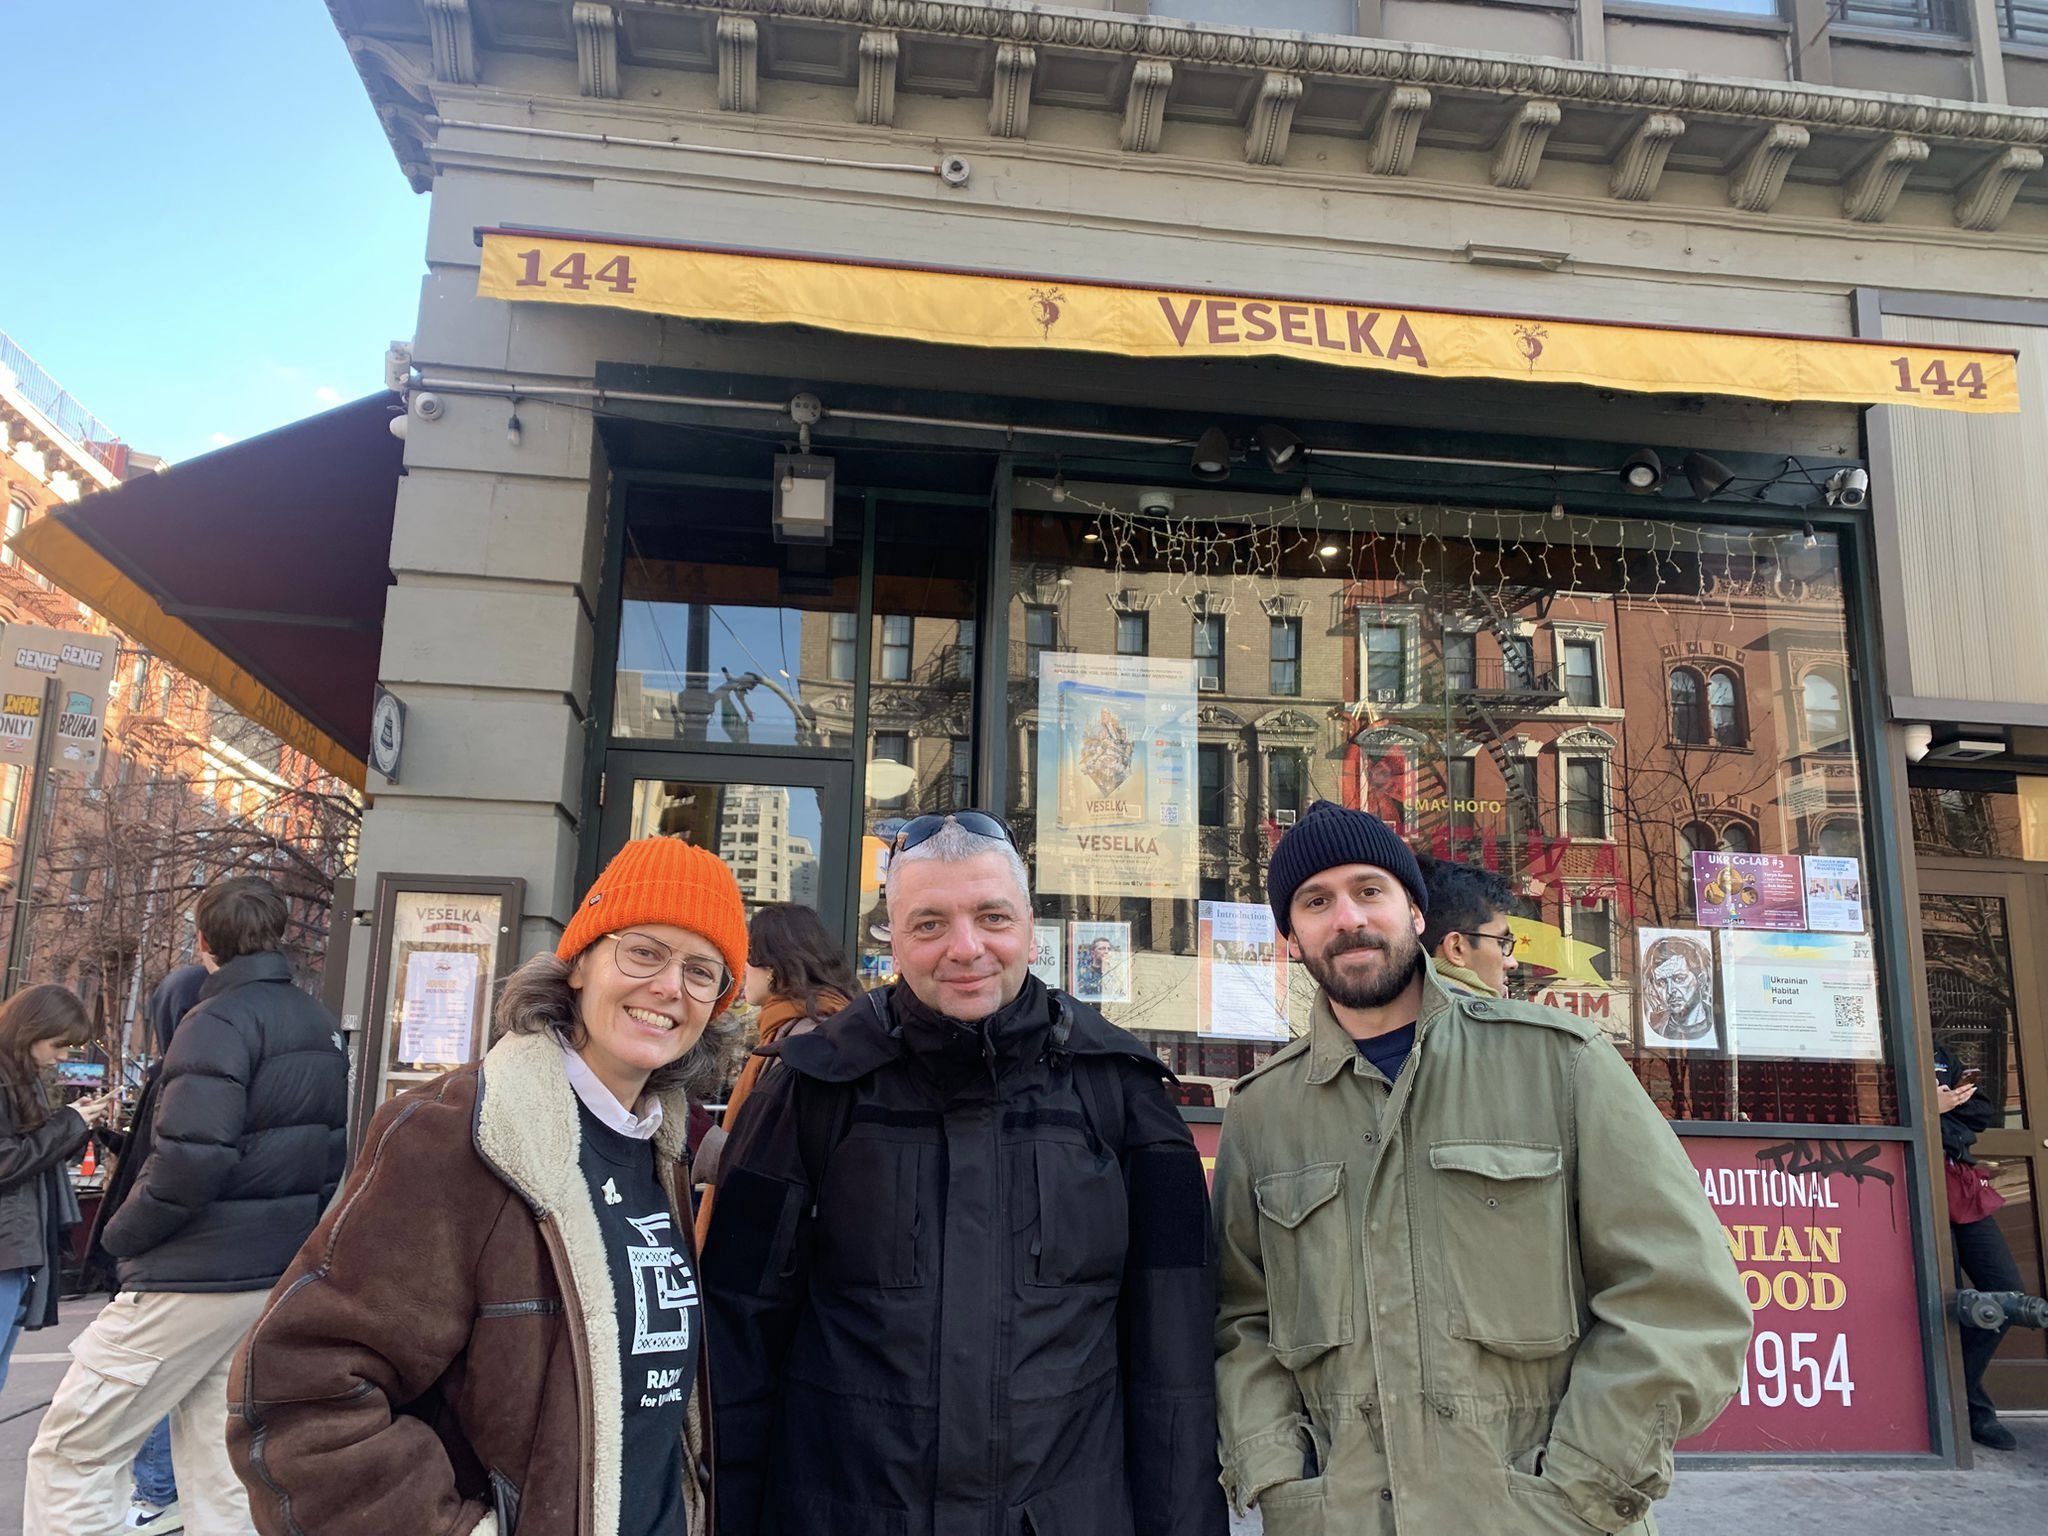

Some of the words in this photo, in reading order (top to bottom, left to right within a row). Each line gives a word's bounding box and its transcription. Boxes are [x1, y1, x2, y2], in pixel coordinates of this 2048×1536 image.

[516, 249, 637, 294] 144
[1158, 297, 1429, 368] VESELKA
[1890, 356, 1988, 399] 144
[16, 648, 59, 673] GENIE
[61, 645, 103, 670] GENIE
[59, 714, 98, 738] BRUHA
[1086, 800, 1128, 813] VESELKA
[1077, 834, 1159, 856] VESELKA
[1708, 854, 1730, 864] UKR
[1732, 855, 1769, 866] Co-LAB
[1771, 857, 1785, 869] #3
[416, 907, 482, 924] VESELKA
[1216, 909, 1267, 921] Introduction
[1771, 975, 1808, 985] Ukrainian
[1771, 986, 1800, 995] Habitat
[1772, 997, 1793, 1005] Fund
[1699, 1168, 1839, 1208] ADITIONAL
[1739, 1270, 1847, 1311] OOD
[640, 1394, 657, 1407] for
